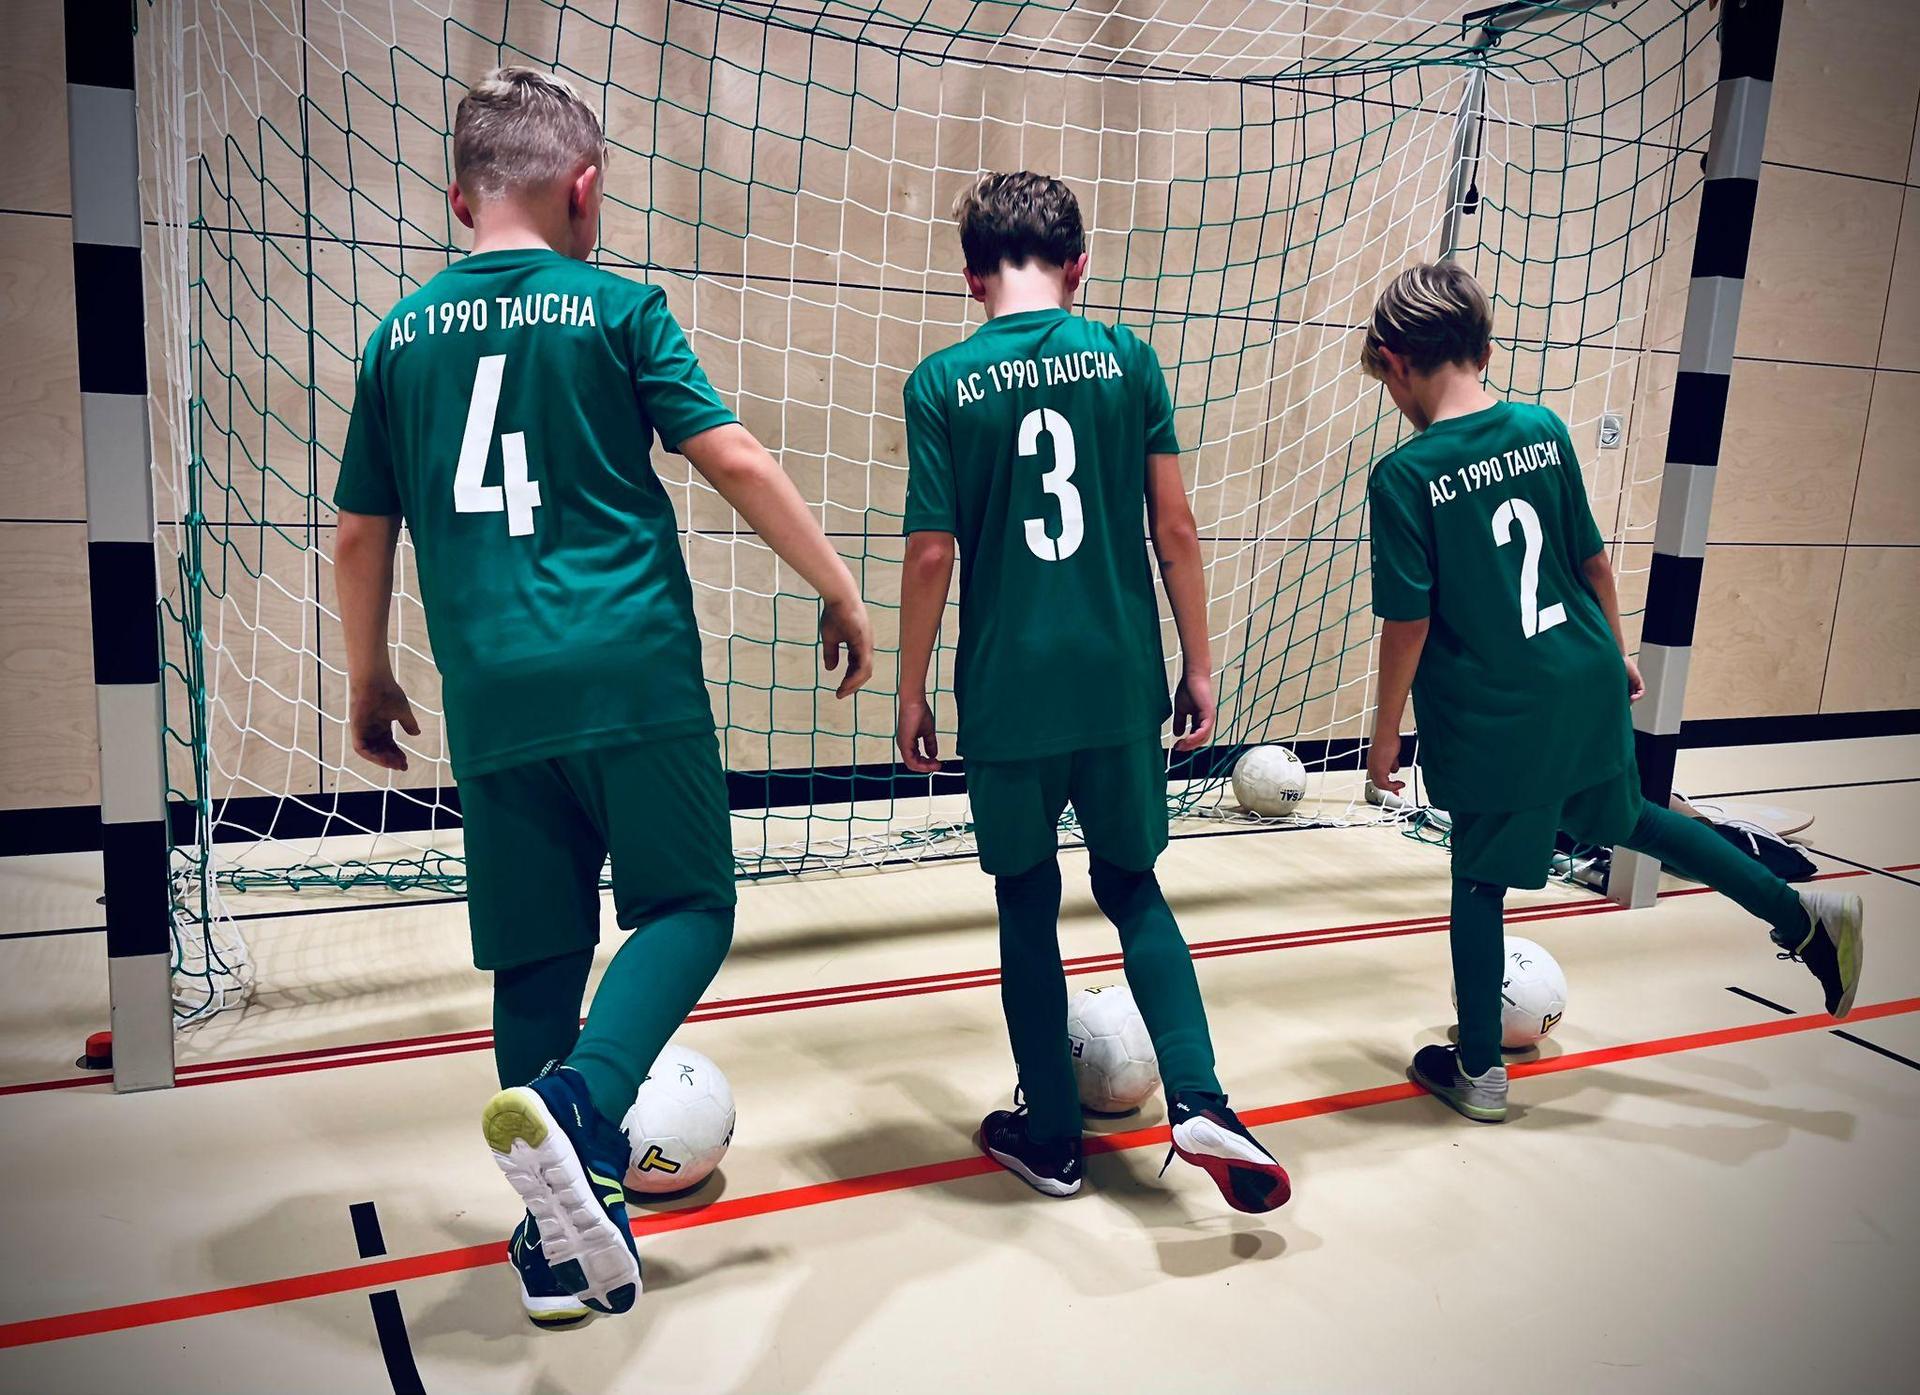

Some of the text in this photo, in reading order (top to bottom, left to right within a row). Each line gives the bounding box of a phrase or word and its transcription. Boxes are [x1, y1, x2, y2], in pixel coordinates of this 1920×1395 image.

[390, 293, 596, 350] AC 1990 TAUCHA
[957, 350, 1123, 407] AC 1990 TAUCHA
[453, 353, 542, 537] 4
[1018, 407, 1085, 562] 3
[1428, 474, 1457, 507] AC
[1457, 457, 1504, 493] 1990
[1492, 497, 1567, 639] 2
[1510, 952, 1533, 971] AC
[676, 1063, 695, 1087] AC
[637, 1144, 682, 1175] T
